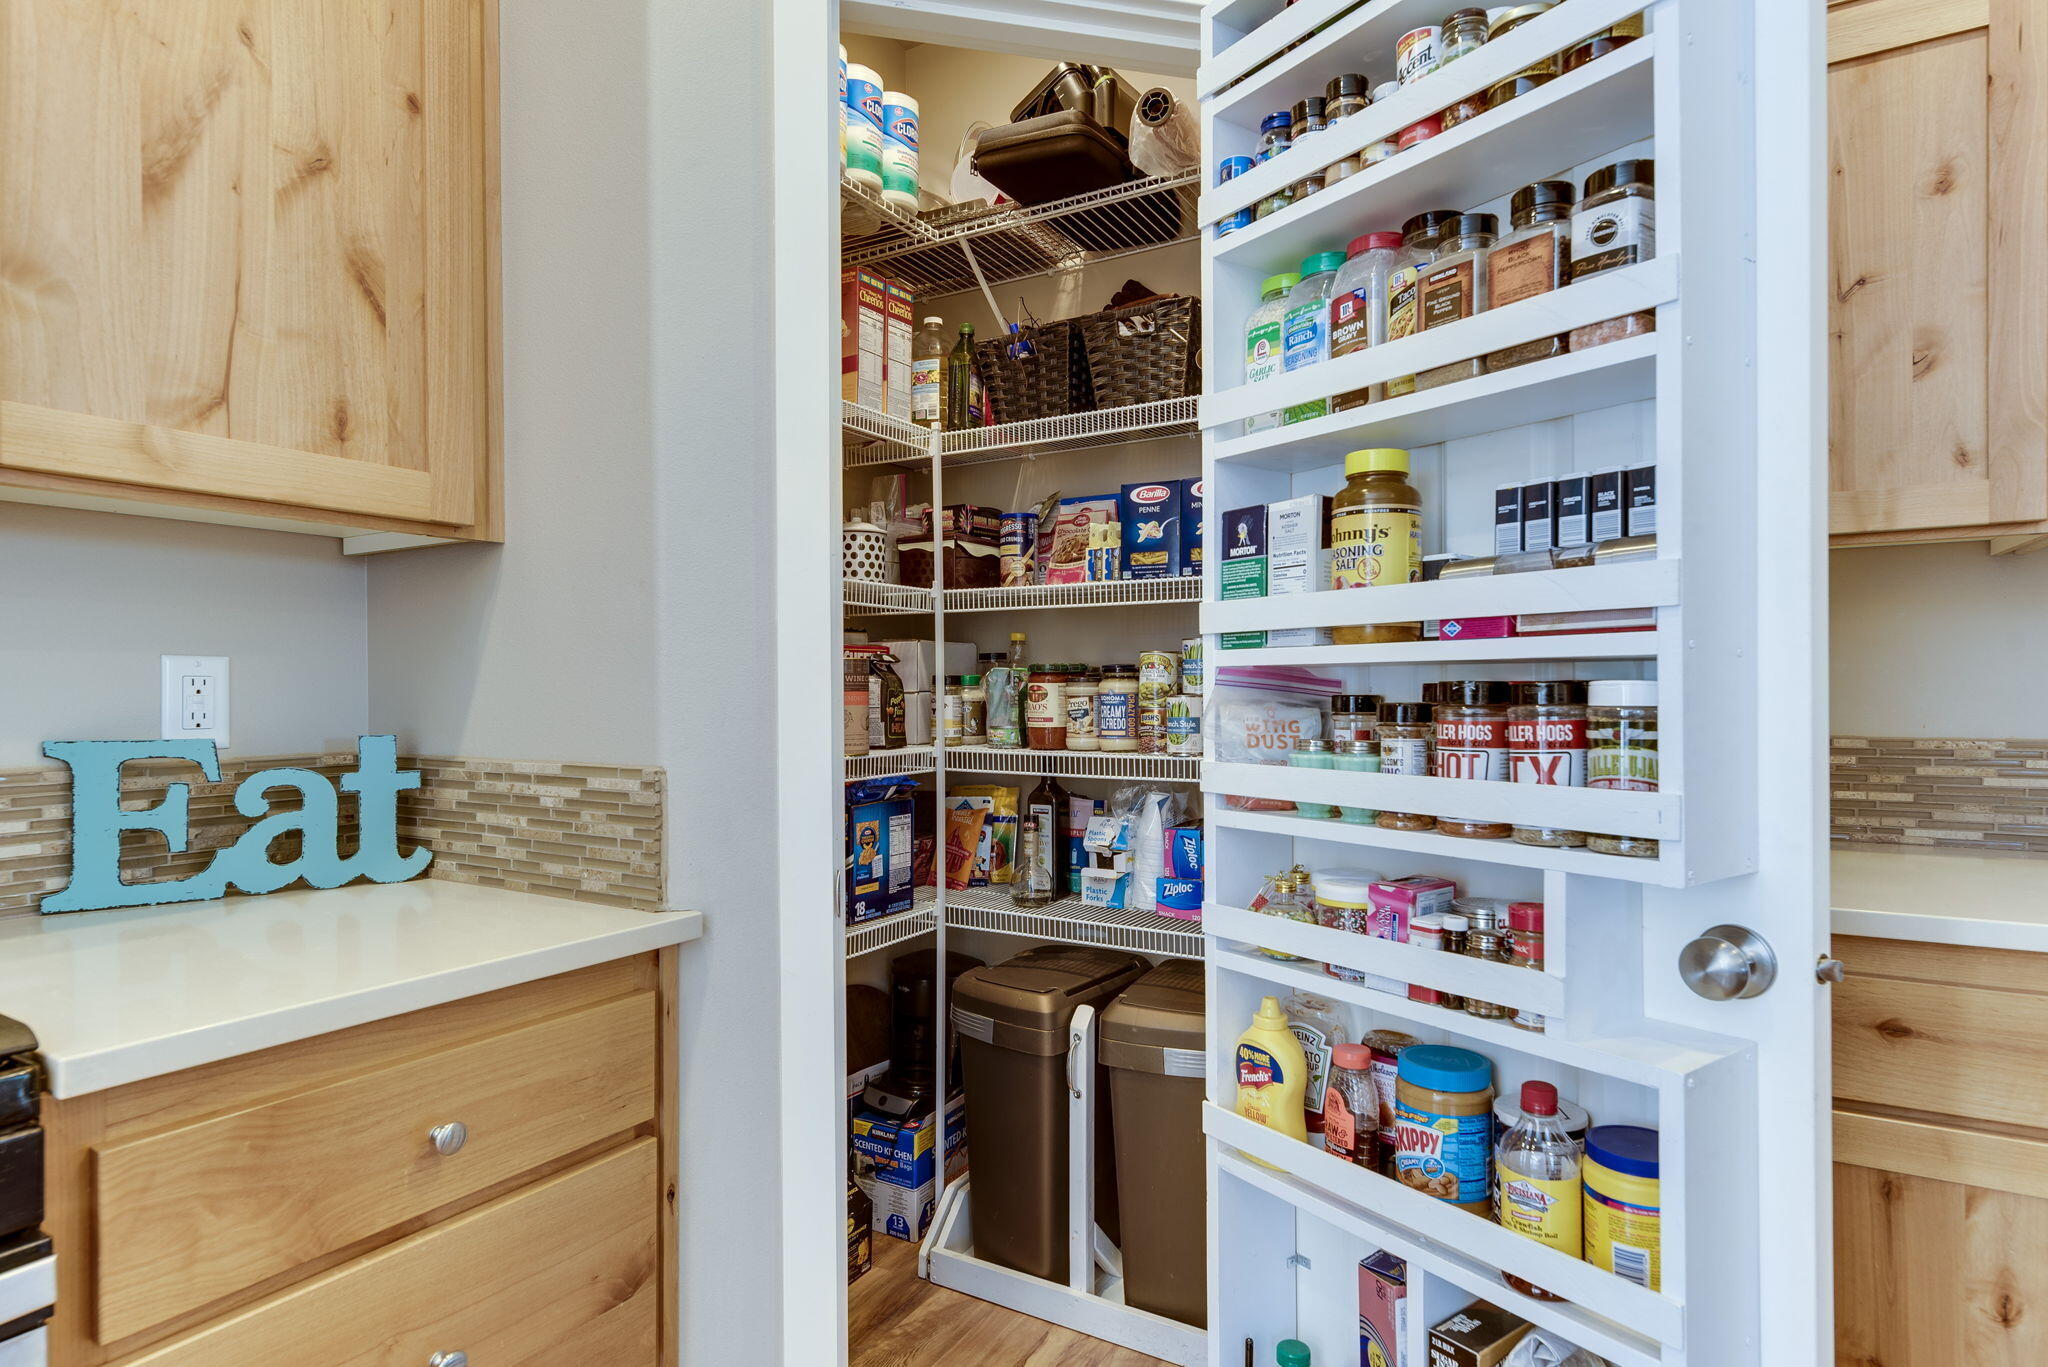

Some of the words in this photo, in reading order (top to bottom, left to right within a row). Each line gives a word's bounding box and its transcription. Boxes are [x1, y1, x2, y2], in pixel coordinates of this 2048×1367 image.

[860, 289, 884, 309] Cheerios
[1398, 286, 1416, 304] Taco
[888, 301, 912, 321] Cheerios
[1434, 300, 1452, 310] BLACK
[1288, 329, 1313, 346] Ranch
[1332, 320, 1364, 340] BROWN
[1338, 332, 1358, 343] GRAVY
[1285, 348, 1318, 367] SEASONING
[1249, 364, 1276, 379] GARLIC
[1139, 488, 1167, 499] Barilla
[1138, 505, 1160, 513] PENNE
[1280, 512, 1300, 520] MORTON
[1057, 527, 1087, 535] Chocolate
[1332, 523, 1390, 543] ohnny's
[1230, 546, 1256, 557] MORTON
[1333, 544, 1383, 559] SONING
[1336, 557, 1357, 571] SALT
[1180, 721, 1196, 729] Style
[1436, 723, 1456, 739] LLER
[1458, 724, 1492, 741] HOGS
[1536, 725, 1573, 741] HOGS
[1247, 734, 1300, 750] DUST
[1383, 759, 1404, 767] LCOM'S
[1510, 756, 1562, 785] TX
[40, 735, 433, 915] Eat
[1183, 837, 1198, 869] Ziploc
[1086, 886, 1108, 895] Plastic
[1163, 883, 1193, 897] Ziploc
[1086, 894, 1104, 902] Forks
[855, 901, 866, 916] 18
[1240, 1046, 1255, 1060] 40%
[1255, 1052, 1271, 1064] MORE
[1305, 1050, 1320, 1062] ATO
[1240, 1069, 1270, 1083] French's
[1244, 1107, 1267, 1124] YELLOW
[854, 1138, 883, 1154] SCENTED
[884, 1146, 912, 1161] KICHEN
[892, 1216, 904, 1228] 13
[1511, 1217, 1543, 1232] Crawfish
[1376, 1279, 1384, 1301] 150
